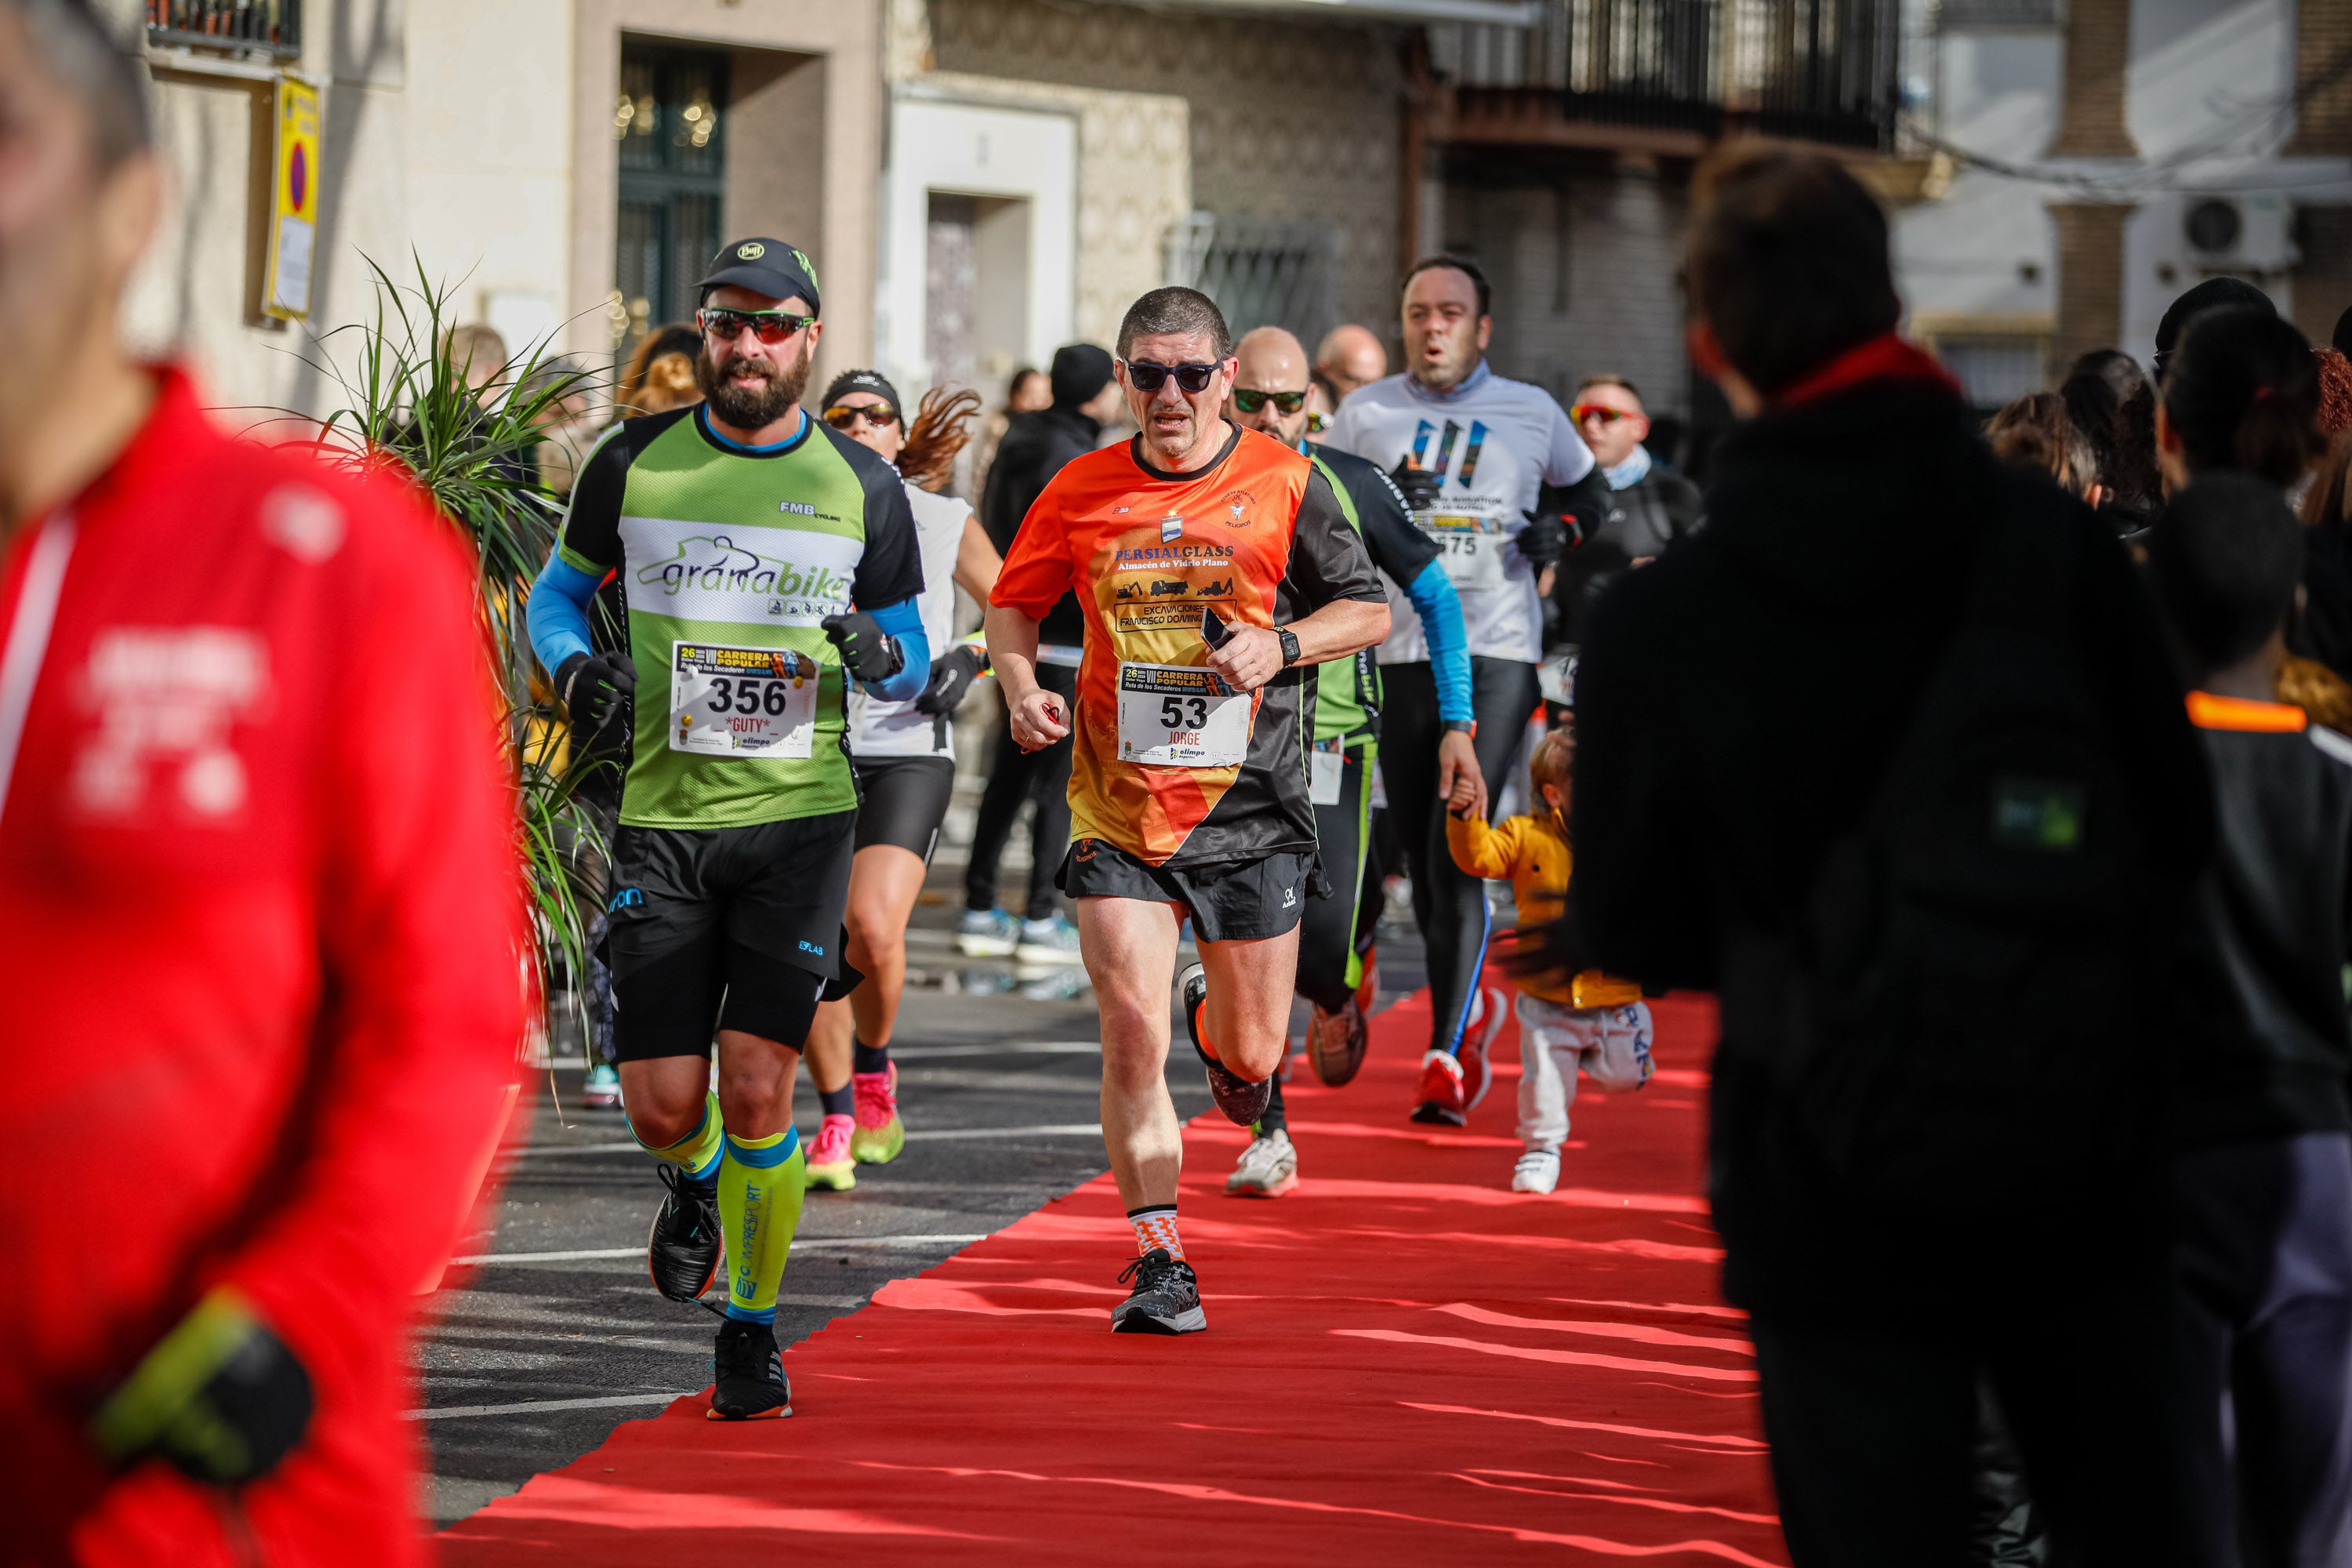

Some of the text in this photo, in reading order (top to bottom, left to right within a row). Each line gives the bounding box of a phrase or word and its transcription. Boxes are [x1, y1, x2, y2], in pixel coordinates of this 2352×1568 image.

[779, 501, 815, 515] FMB
[1116, 546, 1234, 561] PERSIALGLASS
[1118, 559, 1158, 571] Almacén
[1172, 559, 1201, 568] Vidrio
[1144, 604, 1205, 615] EXCAVACIONES
[1120, 615, 1165, 626] FRANCISCO
[681, 647, 695, 658] 26
[717, 650, 771, 661] CARRERA
[717, 659, 770, 668] POPULAR
[713, 665, 745, 674] Secaderos
[1126, 669, 1138, 678] 26
[1146, 670, 1203, 684] VII CARRERA
[1156, 678, 1203, 687] POPULAR
[1153, 684, 1181, 692] Secaderos
[707, 677, 786, 717] 356
[1160, 696, 1207, 729] 53
[742, 737, 770, 746] olimpo
[1168, 731, 1200, 746] JORGE
